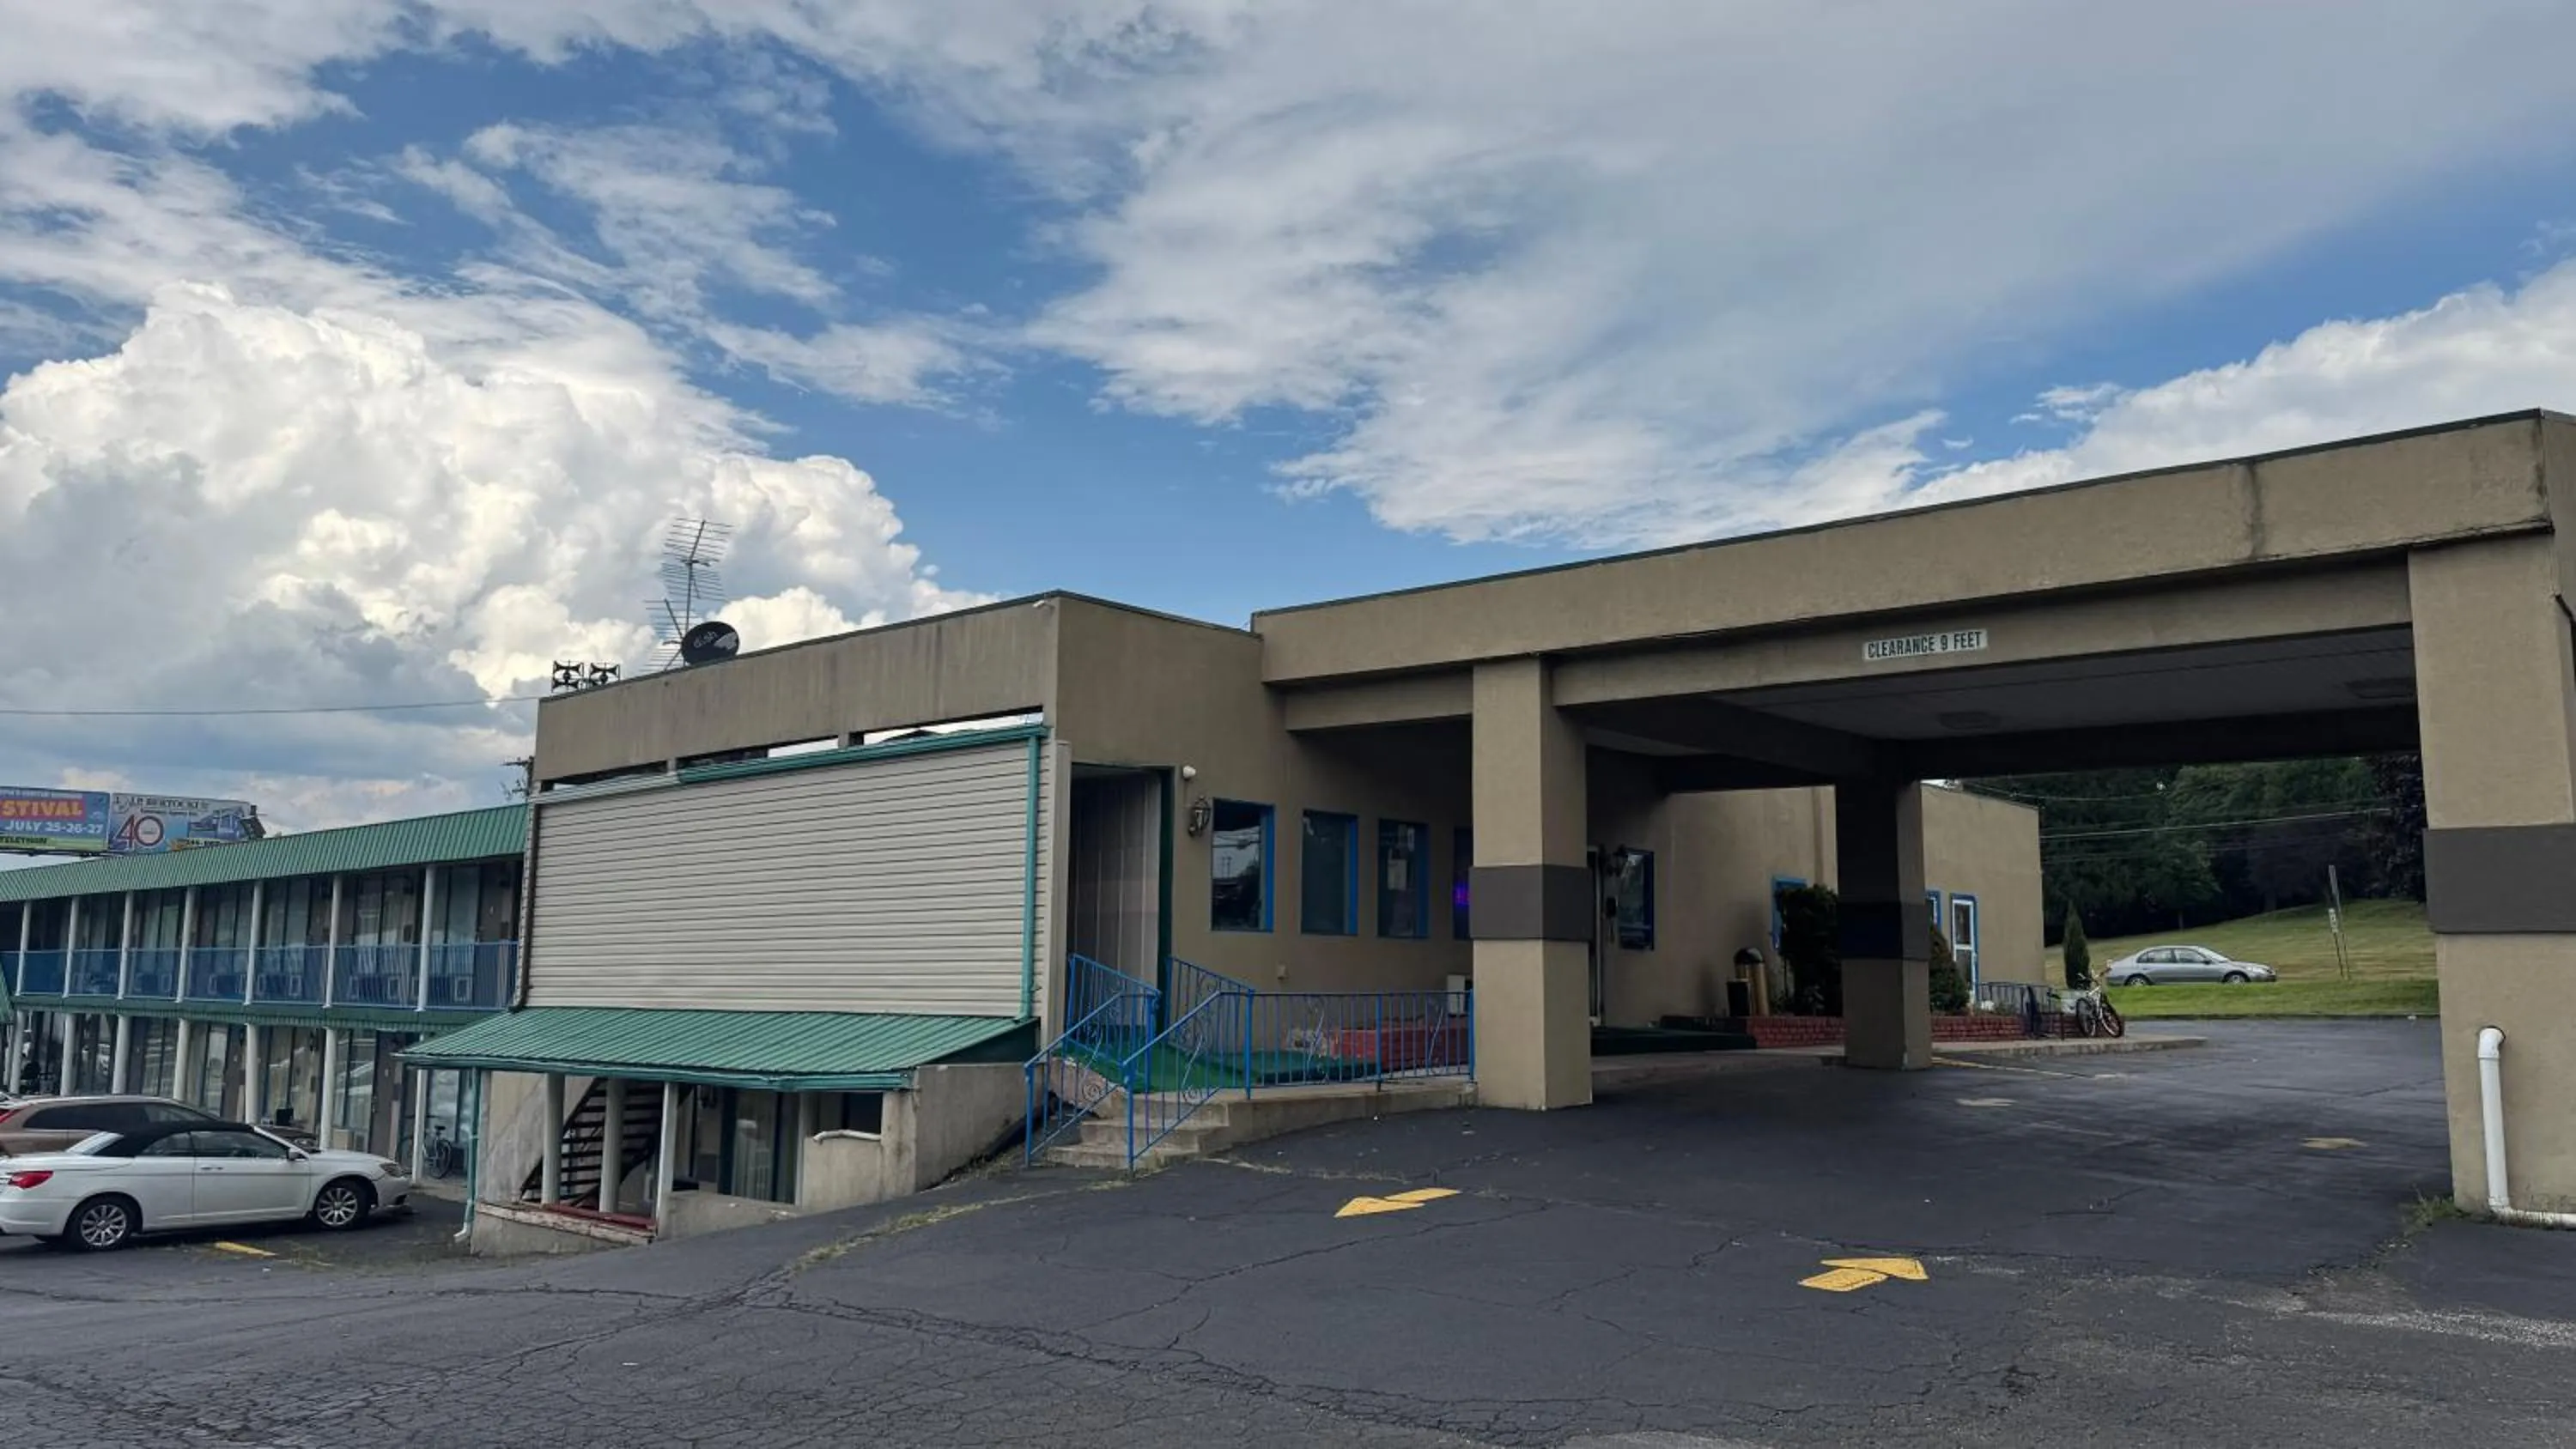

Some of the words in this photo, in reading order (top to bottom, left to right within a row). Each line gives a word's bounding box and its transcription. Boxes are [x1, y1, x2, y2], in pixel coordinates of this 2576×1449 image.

[1868, 635, 1935, 658] CLEARANCE
[1941, 634, 1948, 651] 9
[1953, 631, 1981, 650] FEET
[1, 799, 83, 817] STIVAL
[5, 820, 41, 833] JULY
[114, 814, 164, 851] 40
